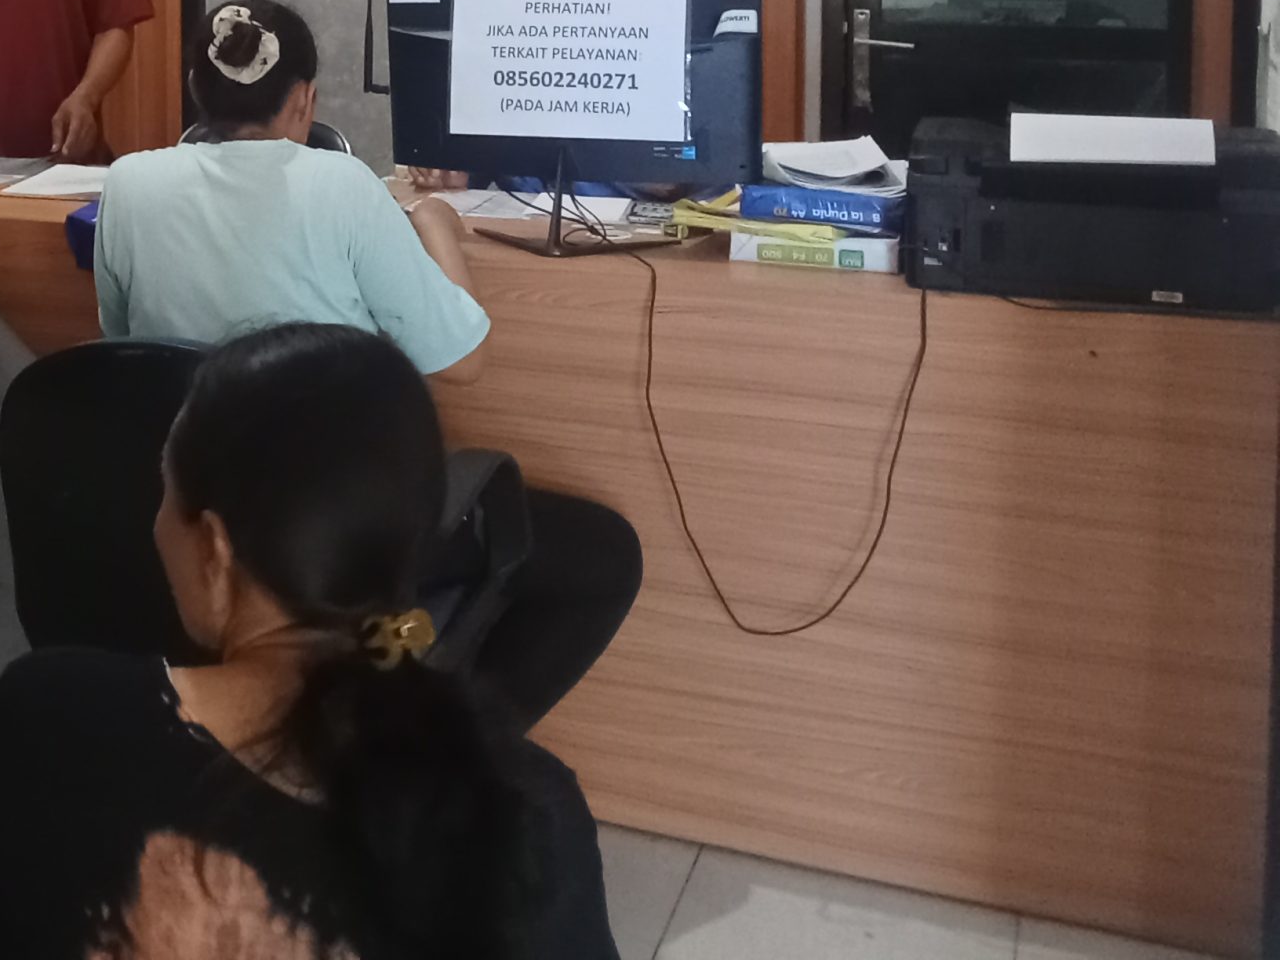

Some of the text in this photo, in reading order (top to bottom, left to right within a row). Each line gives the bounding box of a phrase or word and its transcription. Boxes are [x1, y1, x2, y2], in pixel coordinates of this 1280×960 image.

[525, 2, 611, 15] PERHATIAN!
[486, 25, 649, 39] JIKA ADA PERTANYAAN
[491, 46, 546, 59] TERKAIT
[493, 70, 639, 91] 085602240271
[500, 97, 631, 116] (PADA JAM KERJA)
[812, 208, 849, 221] Dunia
